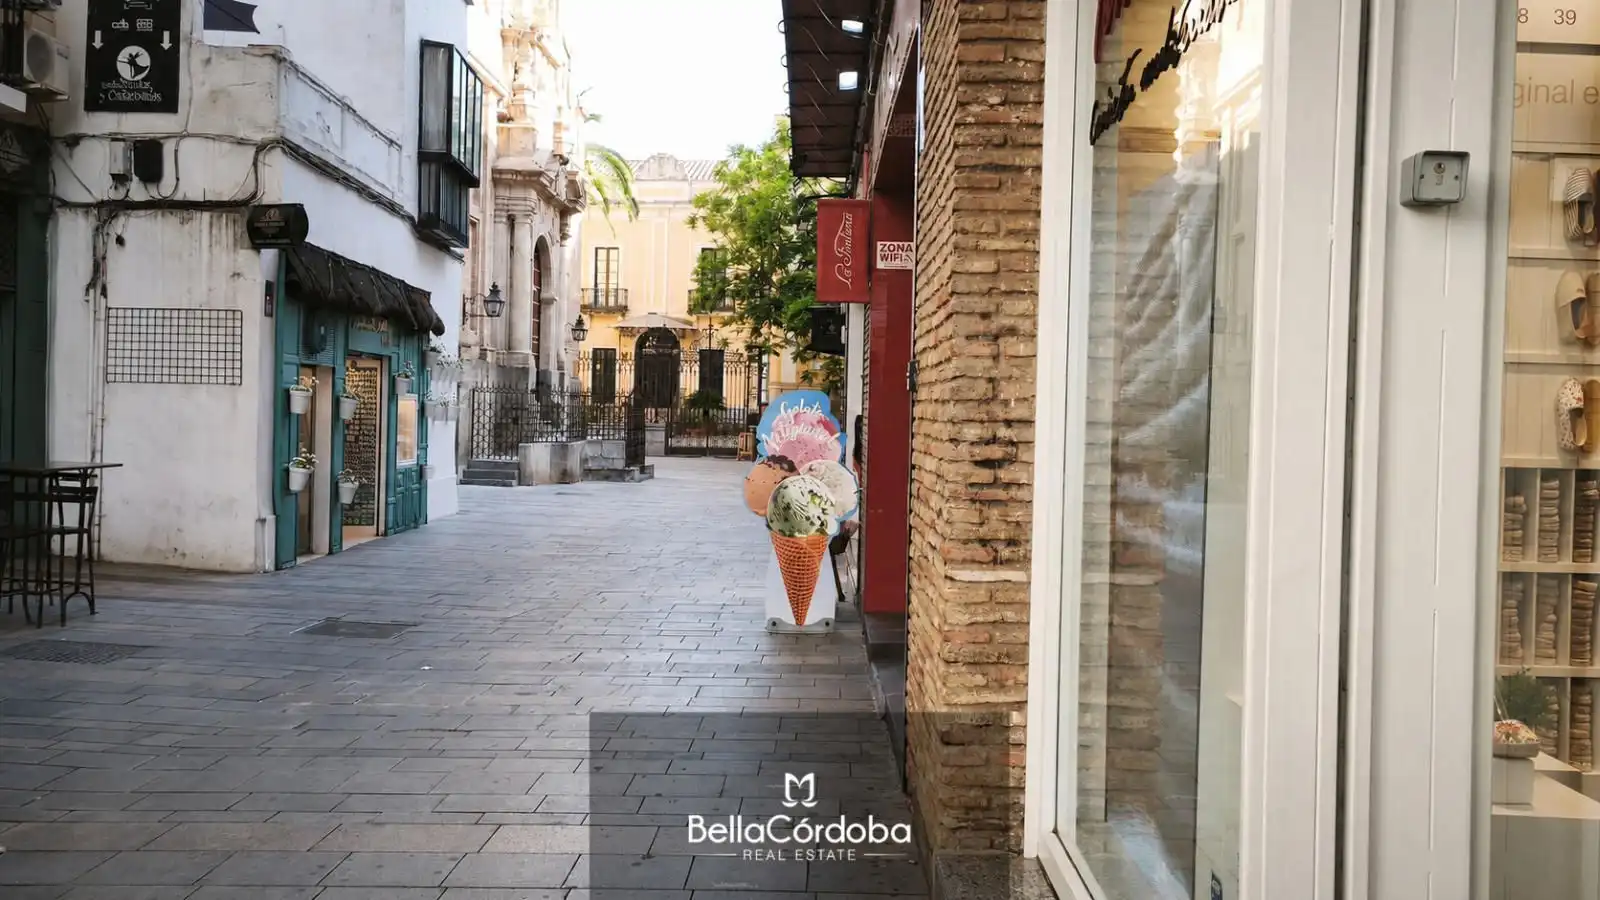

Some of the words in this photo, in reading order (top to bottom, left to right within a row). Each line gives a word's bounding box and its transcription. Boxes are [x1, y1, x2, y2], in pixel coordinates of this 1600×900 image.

[1553, 9, 1577, 26] 39
[879, 243, 914, 253] ZONA
[879, 253, 903, 262] WIFI
